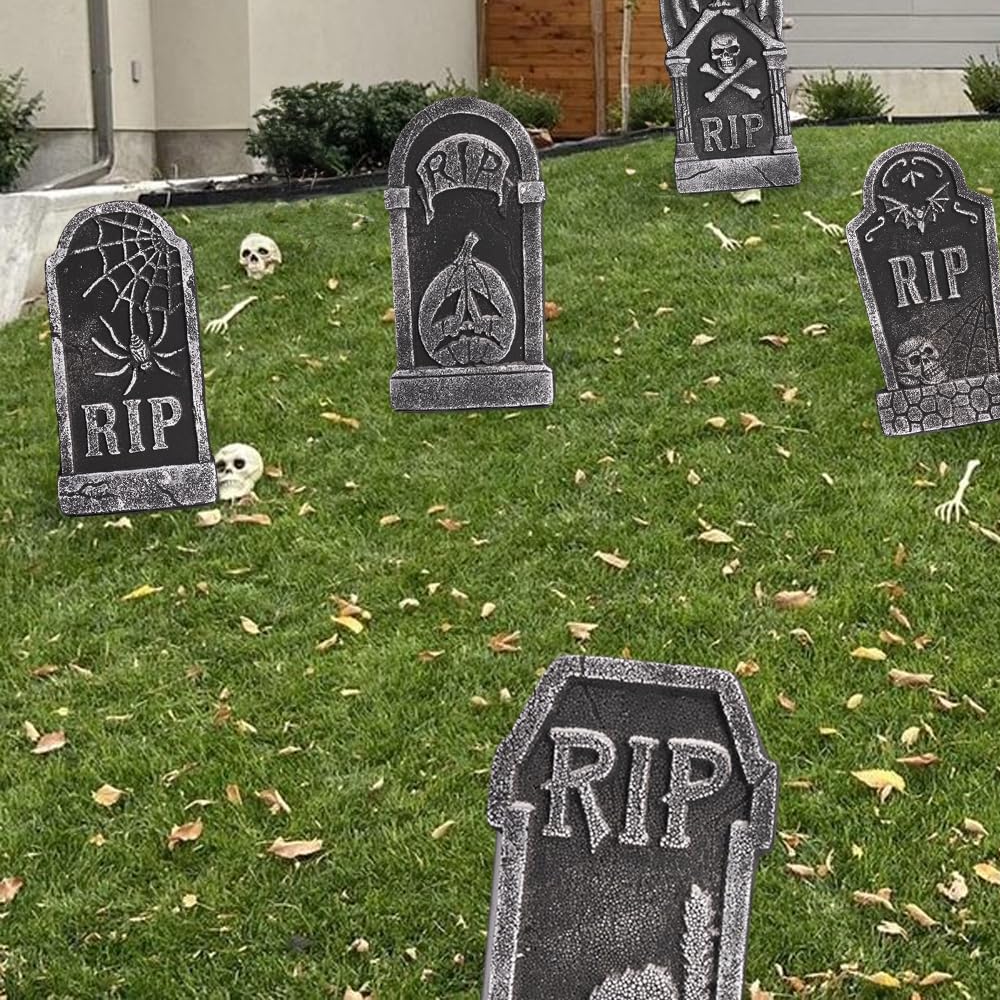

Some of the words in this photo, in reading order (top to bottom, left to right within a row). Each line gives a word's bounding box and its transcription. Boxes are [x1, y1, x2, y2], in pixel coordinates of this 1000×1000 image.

[700, 113, 764, 152] RIP
[424, 141, 502, 192] RIP
[888, 246, 969, 308] RIP
[81, 396, 182, 457] RIP
[541, 727, 732, 854] RIP
